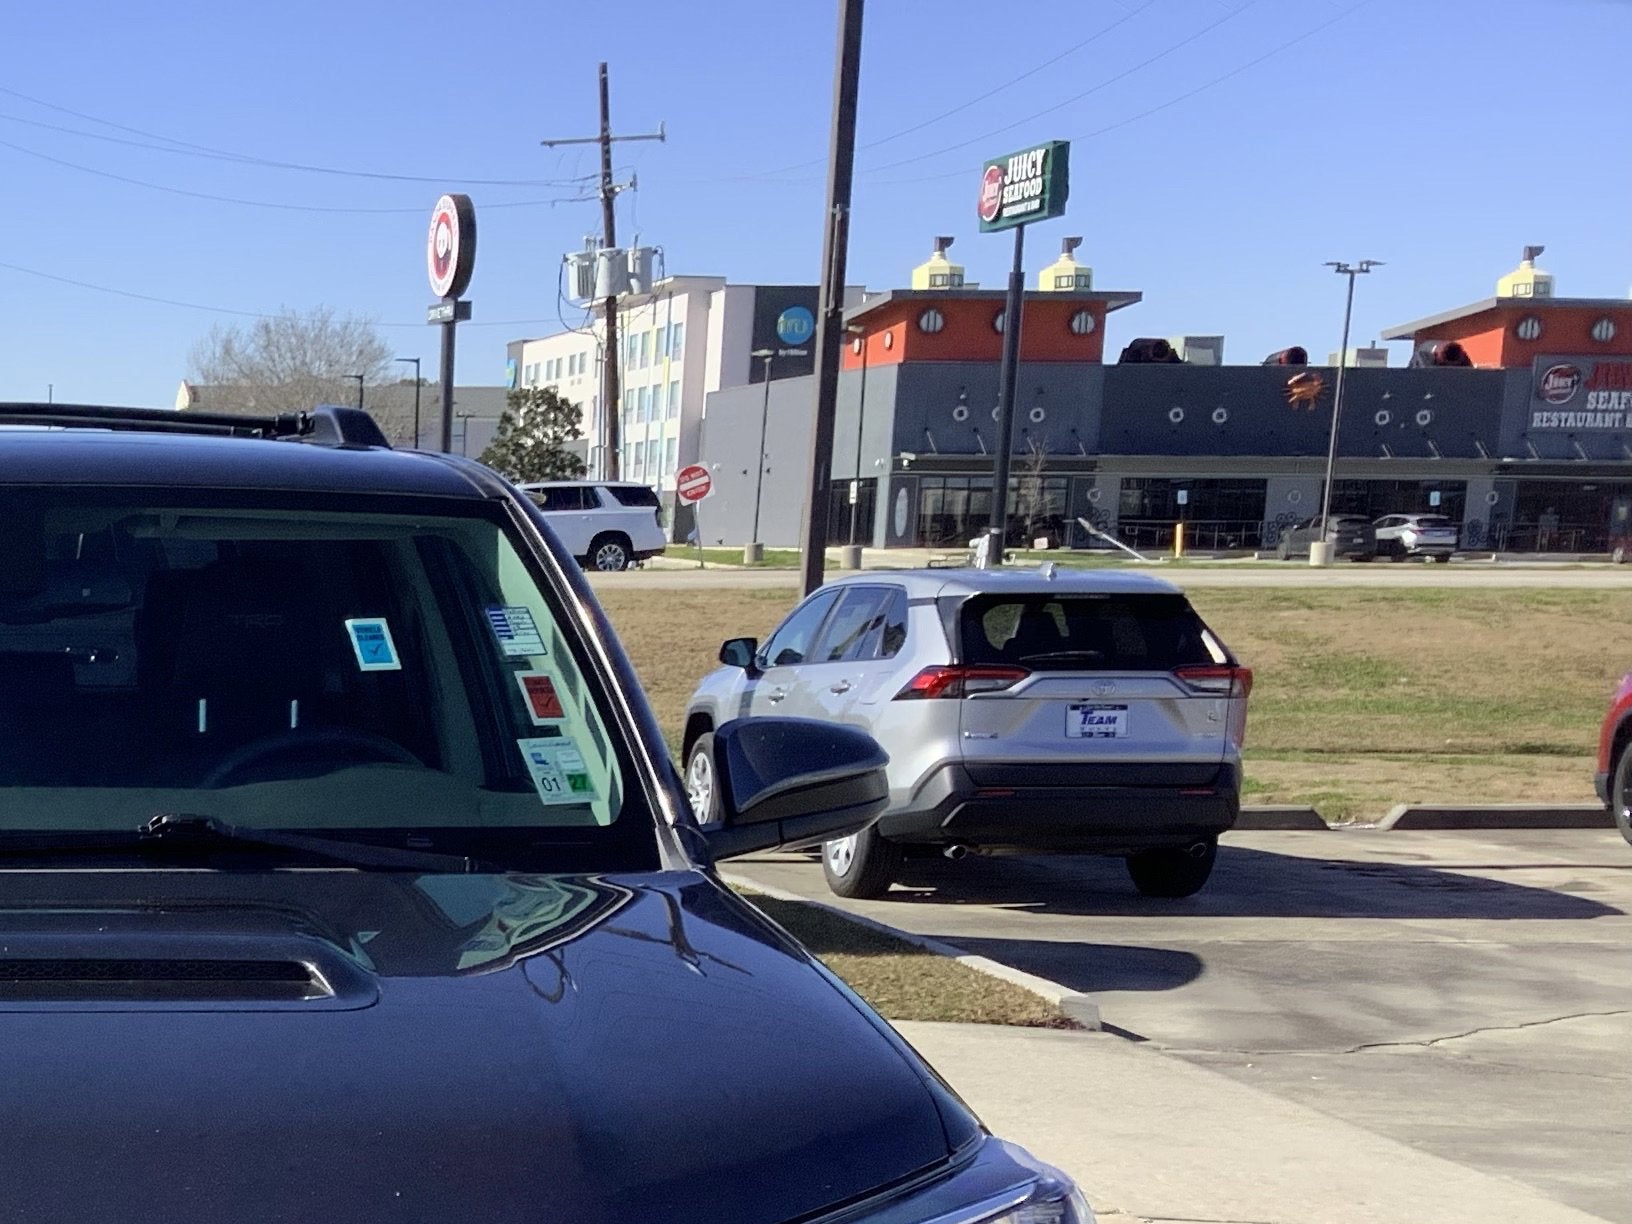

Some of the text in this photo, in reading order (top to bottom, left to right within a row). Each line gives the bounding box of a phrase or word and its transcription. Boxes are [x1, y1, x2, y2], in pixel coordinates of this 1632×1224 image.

[1004, 149, 1046, 185] JUICY
[1003, 177, 1043, 204] SEAFOOD
[1586, 391, 1632, 410] SEAF
[1532, 411, 1623, 428] RESTAURANT
[1081, 707, 1117, 725] TEAM
[542, 777, 561, 792] 01
